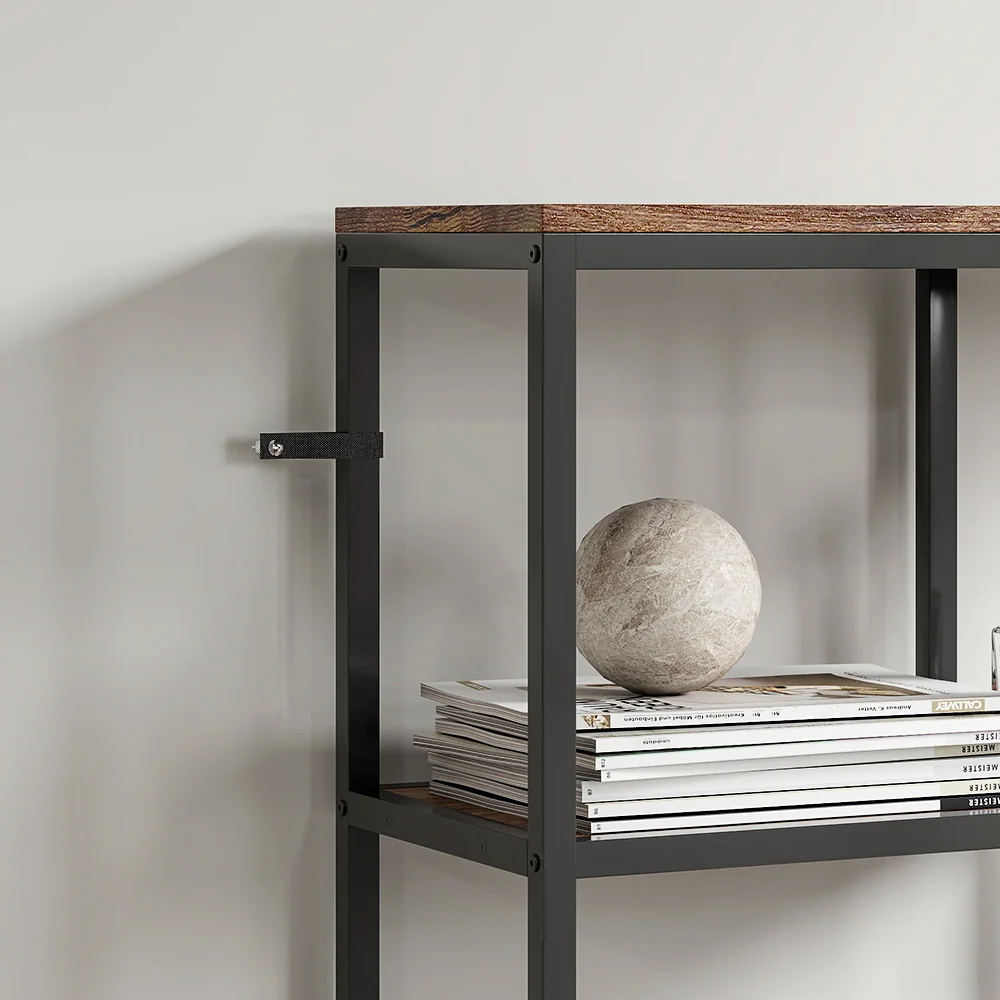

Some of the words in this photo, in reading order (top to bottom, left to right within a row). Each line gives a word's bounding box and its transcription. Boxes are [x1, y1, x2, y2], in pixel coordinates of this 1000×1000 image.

[934, 699, 982, 711] CALLWEY
[705, 712, 745, 720] Kreativatlas
[961, 744, 995, 753] MEISTER
[962, 764, 998, 773] MEISTER
